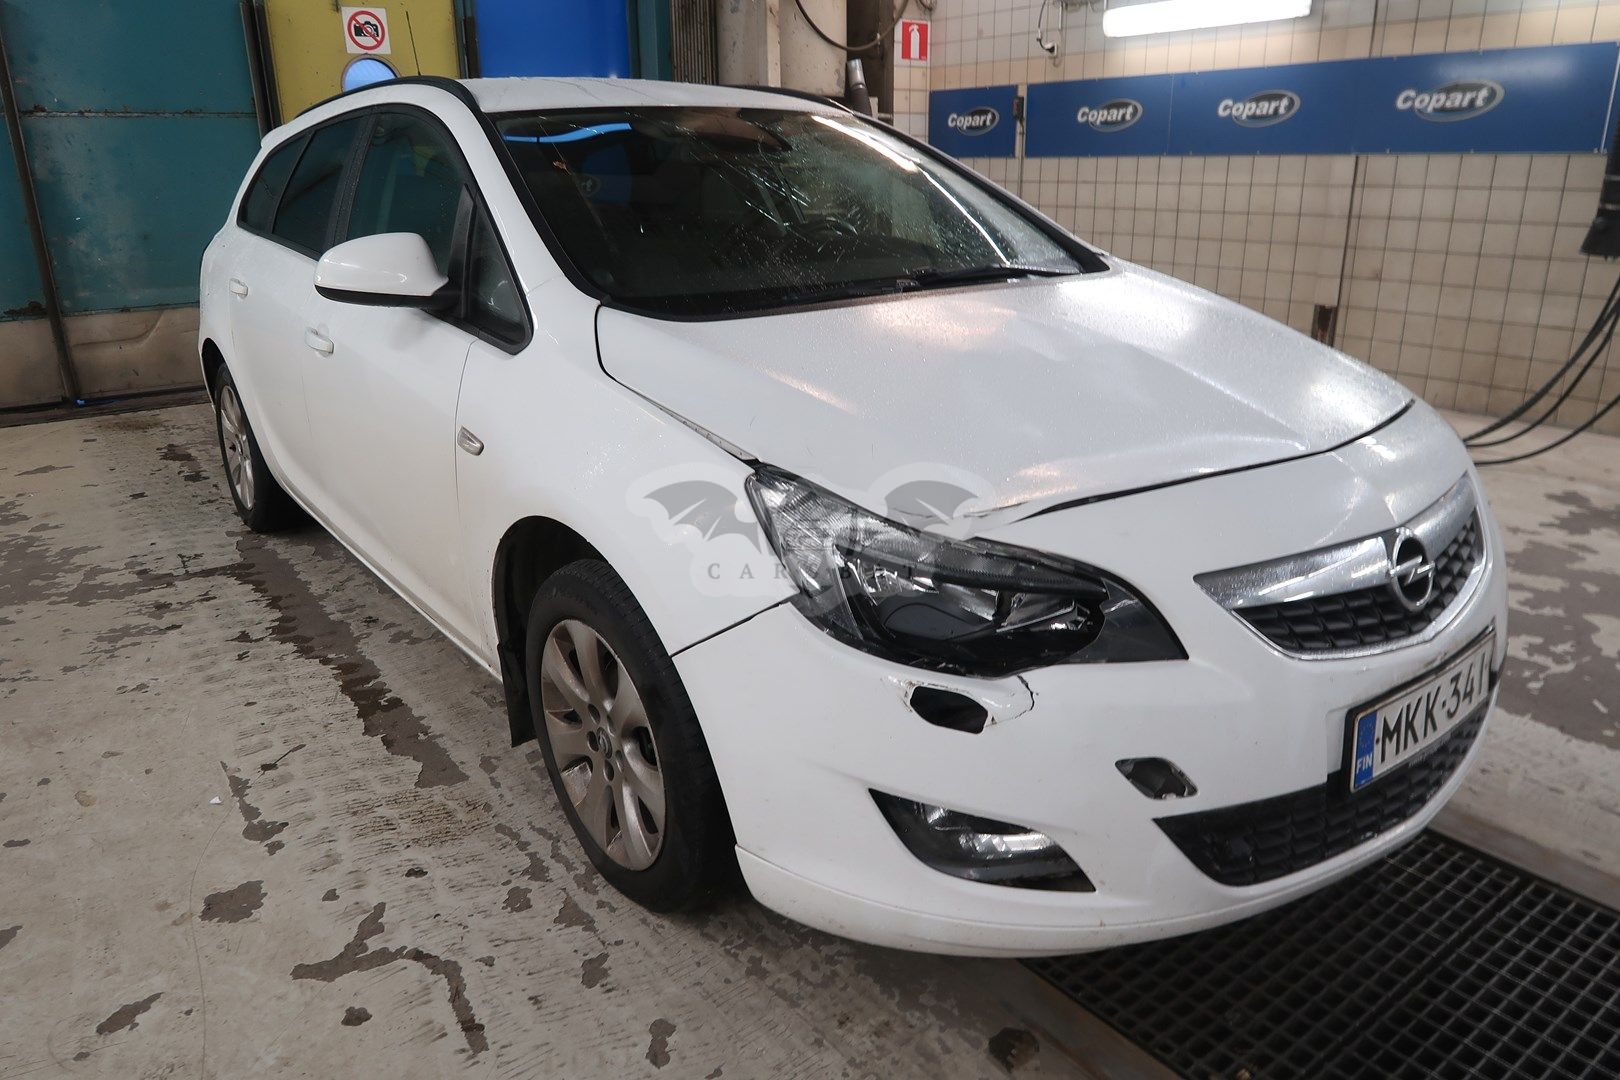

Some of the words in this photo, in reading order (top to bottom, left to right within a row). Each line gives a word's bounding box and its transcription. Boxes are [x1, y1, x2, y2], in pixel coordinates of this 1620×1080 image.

[1217, 96, 1290, 120] Copart
[1395, 87, 1489, 114] Copart
[948, 109, 993, 129] Copart
[1077, 104, 1134, 125] Copart
[1381, 653, 1486, 763] MKK-341
[1356, 752, 1373, 774] FIN
